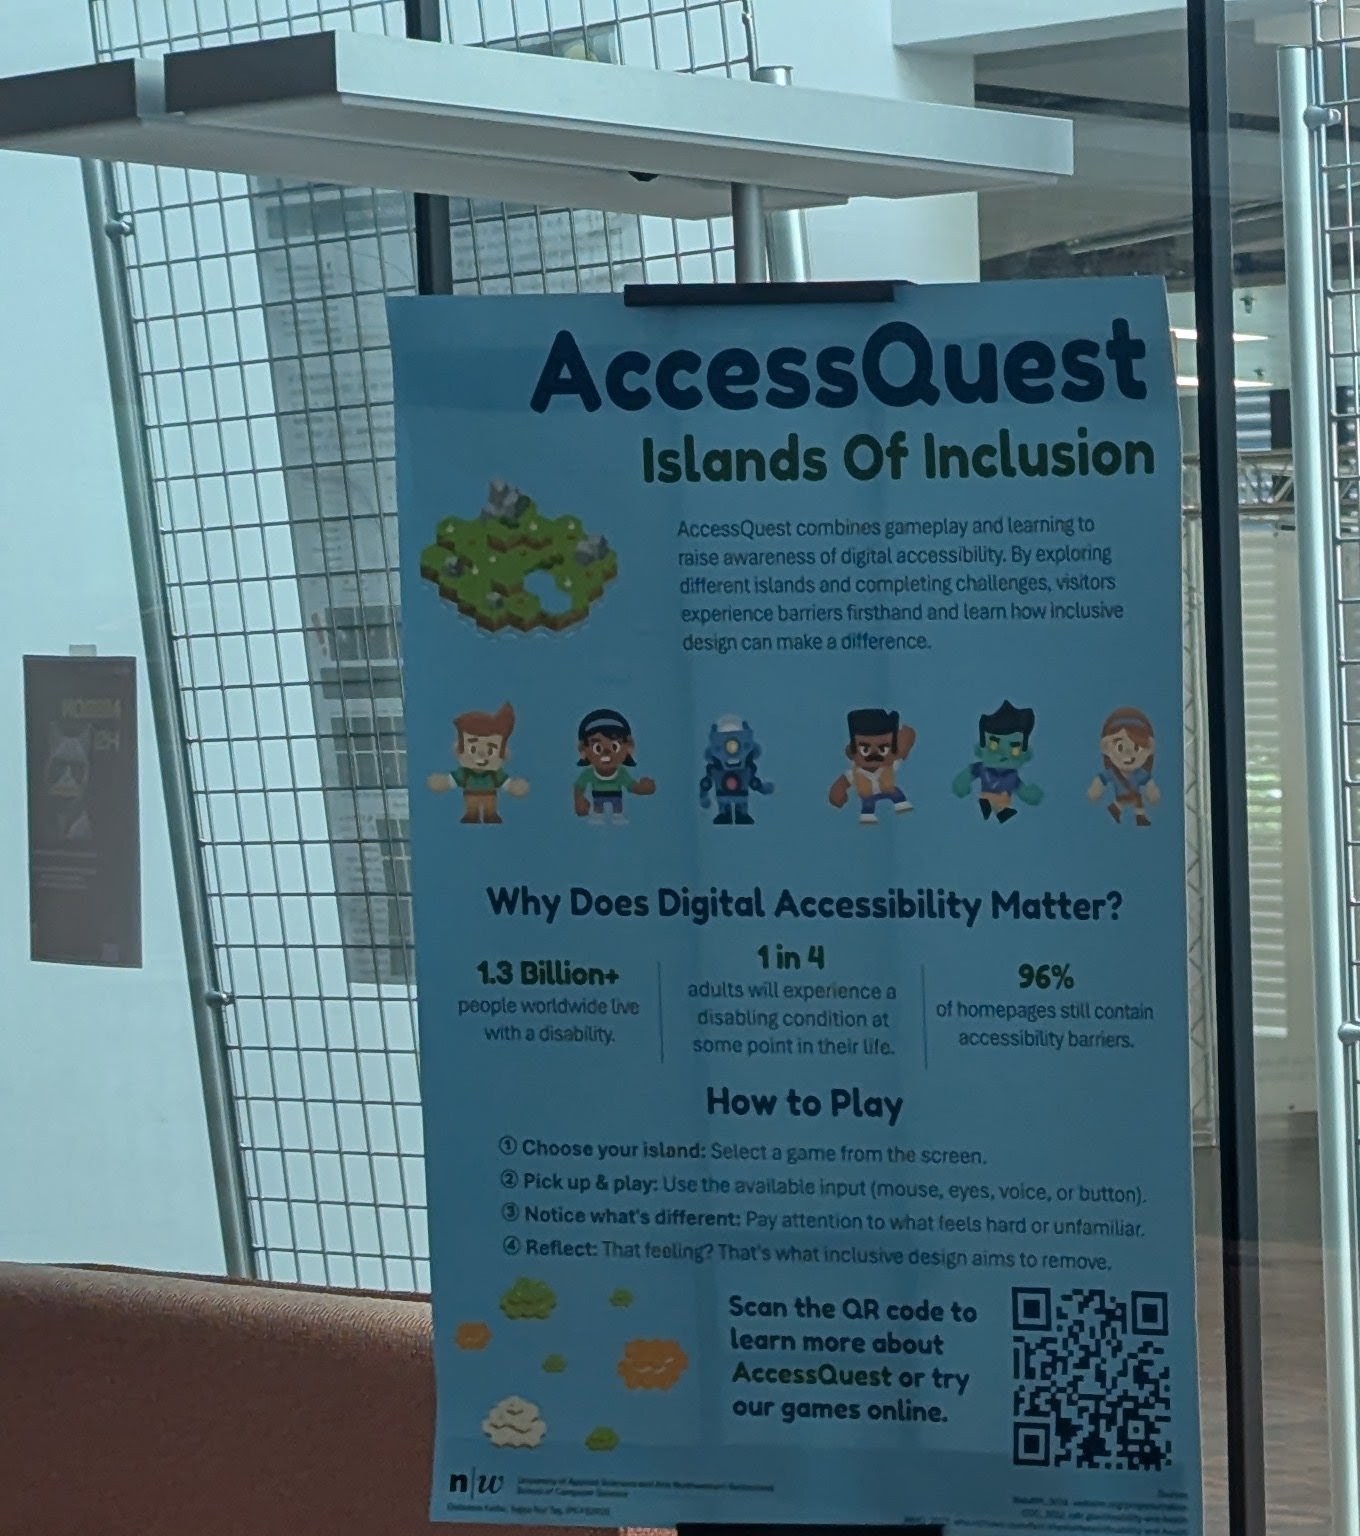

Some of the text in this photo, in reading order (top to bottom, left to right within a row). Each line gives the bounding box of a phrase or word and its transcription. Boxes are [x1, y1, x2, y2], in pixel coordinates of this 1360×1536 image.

[529, 316, 1148, 415] AccessQuest
[642, 427, 1155, 485] Islands Of Inclusion
[676, 514, 1095, 541] AccessQuest combines gameplay and learning to
[677, 542, 1113, 570] raise awareness of digital accessibility. By exploring
[679, 571, 1117, 598] different islands and completing challenges, visitors
[679, 600, 1124, 627] experience barriers firsthand and learn how inclusive
[682, 630, 932, 655] design can make a difference.
[485, 884, 1123, 930] Why Does Digital Accessibility Matter?
[756, 943, 825, 971] 1 in 4
[476, 958, 620, 987] 1.3 Billion+
[1018, 962, 1075, 991] 96%
[687, 979, 897, 1004] adults will experience a
[457, 996, 640, 1018] people worldwide live
[696, 1007, 890, 1032] disabling condition at
[935, 998, 1154, 1024] of homepages still contain
[483, 1024, 616, 1048] with a disability.
[692, 1036, 896, 1058] some point in their life.
[958, 1028, 1135, 1052] accessibility barriers.
[706, 1085, 904, 1128] How to Play
[521, 1138, 988, 1166] Choose your island: Select a game from the screen.
[523, 1171, 1147, 1208] Pick up & play: Use the available input (mouse, eyes, voice, or button).
[524, 1204, 1145, 1239] Notice what's different: Pay attention to what feels hard or unfamiliar.
[525, 1237, 1113, 1272] Reflect: That feeling? That's what inclusive design aims to remove.
[728, 1293, 978, 1324] Scan the QR code to
[730, 1325, 945, 1357] learn more about
[731, 1359, 971, 1397] AccessQuest or try
[732, 1397, 948, 1425] our games online.
